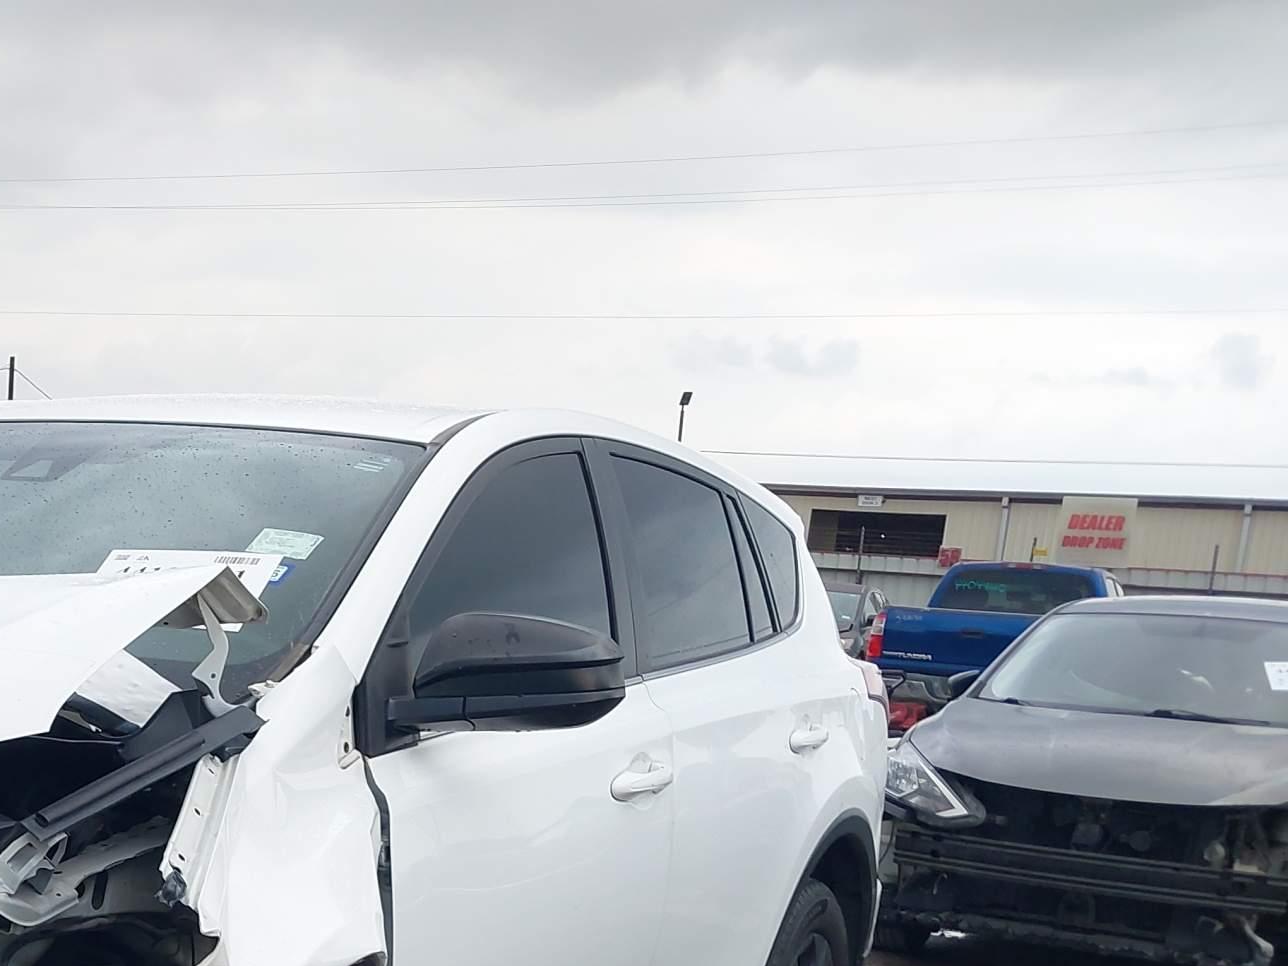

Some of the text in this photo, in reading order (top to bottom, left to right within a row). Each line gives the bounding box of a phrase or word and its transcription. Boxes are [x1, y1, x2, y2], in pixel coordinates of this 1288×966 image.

[1067, 514, 1126, 532] DEALER
[1062, 535, 1127, 551] DROP ZONE
